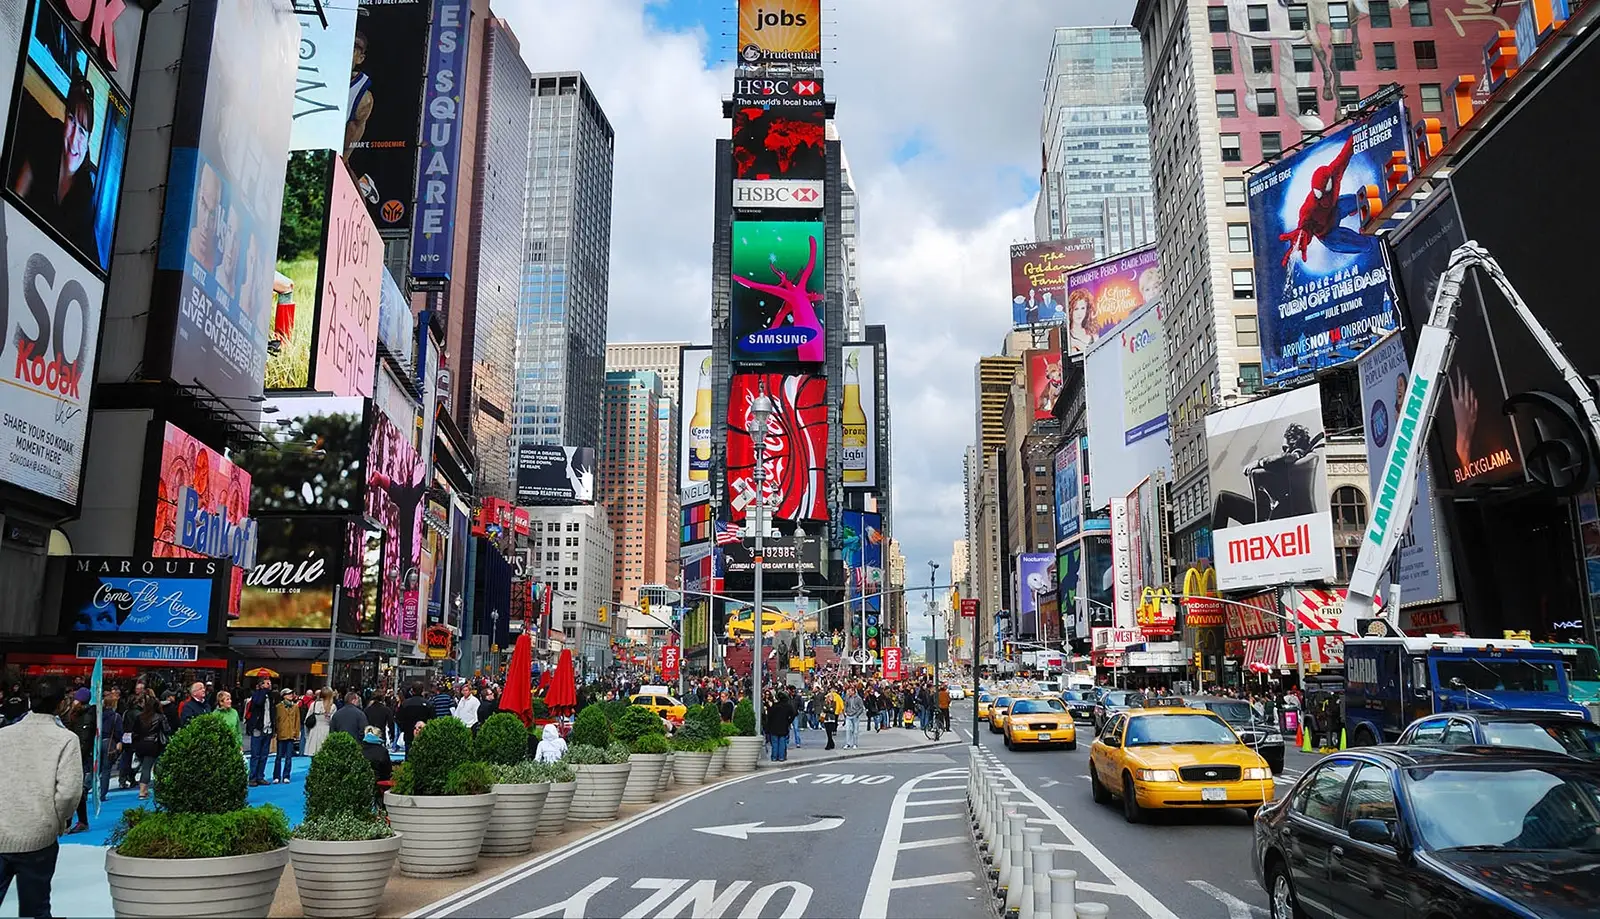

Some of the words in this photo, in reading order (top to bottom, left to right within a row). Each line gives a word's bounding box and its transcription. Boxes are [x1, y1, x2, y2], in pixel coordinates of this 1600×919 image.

[755, 9, 807, 31] jobs
[762, 49, 818, 60] Prudential
[737, 80, 789, 95] HSBC
[803, 98, 822, 106] bank
[1352, 127, 1369, 145] JULIE
[1393, 115, 1398, 125] &
[349, 141, 370, 149] AMAR'E
[370, 140, 406, 149] STOUDEMIRE
[422, 69, 457, 233] SQUARE
[1353, 139, 1370, 154] GLEN
[1278, 167, 1292, 182] EDGE
[737, 187, 789, 202] HSBC
[420, 254, 439, 262] NYC
[1039, 252, 1066, 262] The
[1028, 273, 1066, 287] Famil
[1278, 295, 1308, 319] TURN
[1308, 287, 1331, 308] OFF
[1331, 278, 1354, 300] THE
[14, 252, 90, 374] SO
[181, 297, 203, 329] LIVE
[204, 319, 219, 344] ON
[191, 286, 213, 319] SAT.
[215, 309, 254, 360] OCTOBER
[749, 334, 808, 345] SAMSUNG
[1282, 338, 1310, 358] ARRIVES
[1310, 331, 1330, 349] NOV
[1330, 327, 1341, 343] 14
[1341, 325, 1352, 340] ON
[1351, 310, 1394, 336] BROADWAY
[15, 340, 82, 400] Kodak
[1365, 361, 1389, 386] POPULAR
[3, 412, 28, 435] SHARE
[28, 423, 46, 443] YOUR
[46, 432, 54, 446] SO
[54, 435, 75, 456] KODAK
[15, 435, 45, 458] MOMENT
[44, 449, 62, 466] HERE
[1368, 374, 1429, 547] LANDMARK
[1454, 447, 1513, 483] BLACKGLAMA
[178, 485, 230, 558] Bank
[231, 517, 251, 568] of
[1228, 523, 1312, 565] maxell
[76, 561, 216, 575] MARQUIS
[246, 550, 324, 586] aerie
[93, 582, 132, 609] Come
[118, 579, 159, 612] Fly
[155, 590, 202, 628] Away
[1553, 619, 1584, 630] MAC
[102, 645, 130, 658] THARP
[154, 645, 189, 659] SINATRA
[255, 638, 309, 648] AMERICAN
[666, 647, 677, 669] tkts
[887, 649, 899, 670] tkts
[1347, 656, 1378, 684] GARDA
